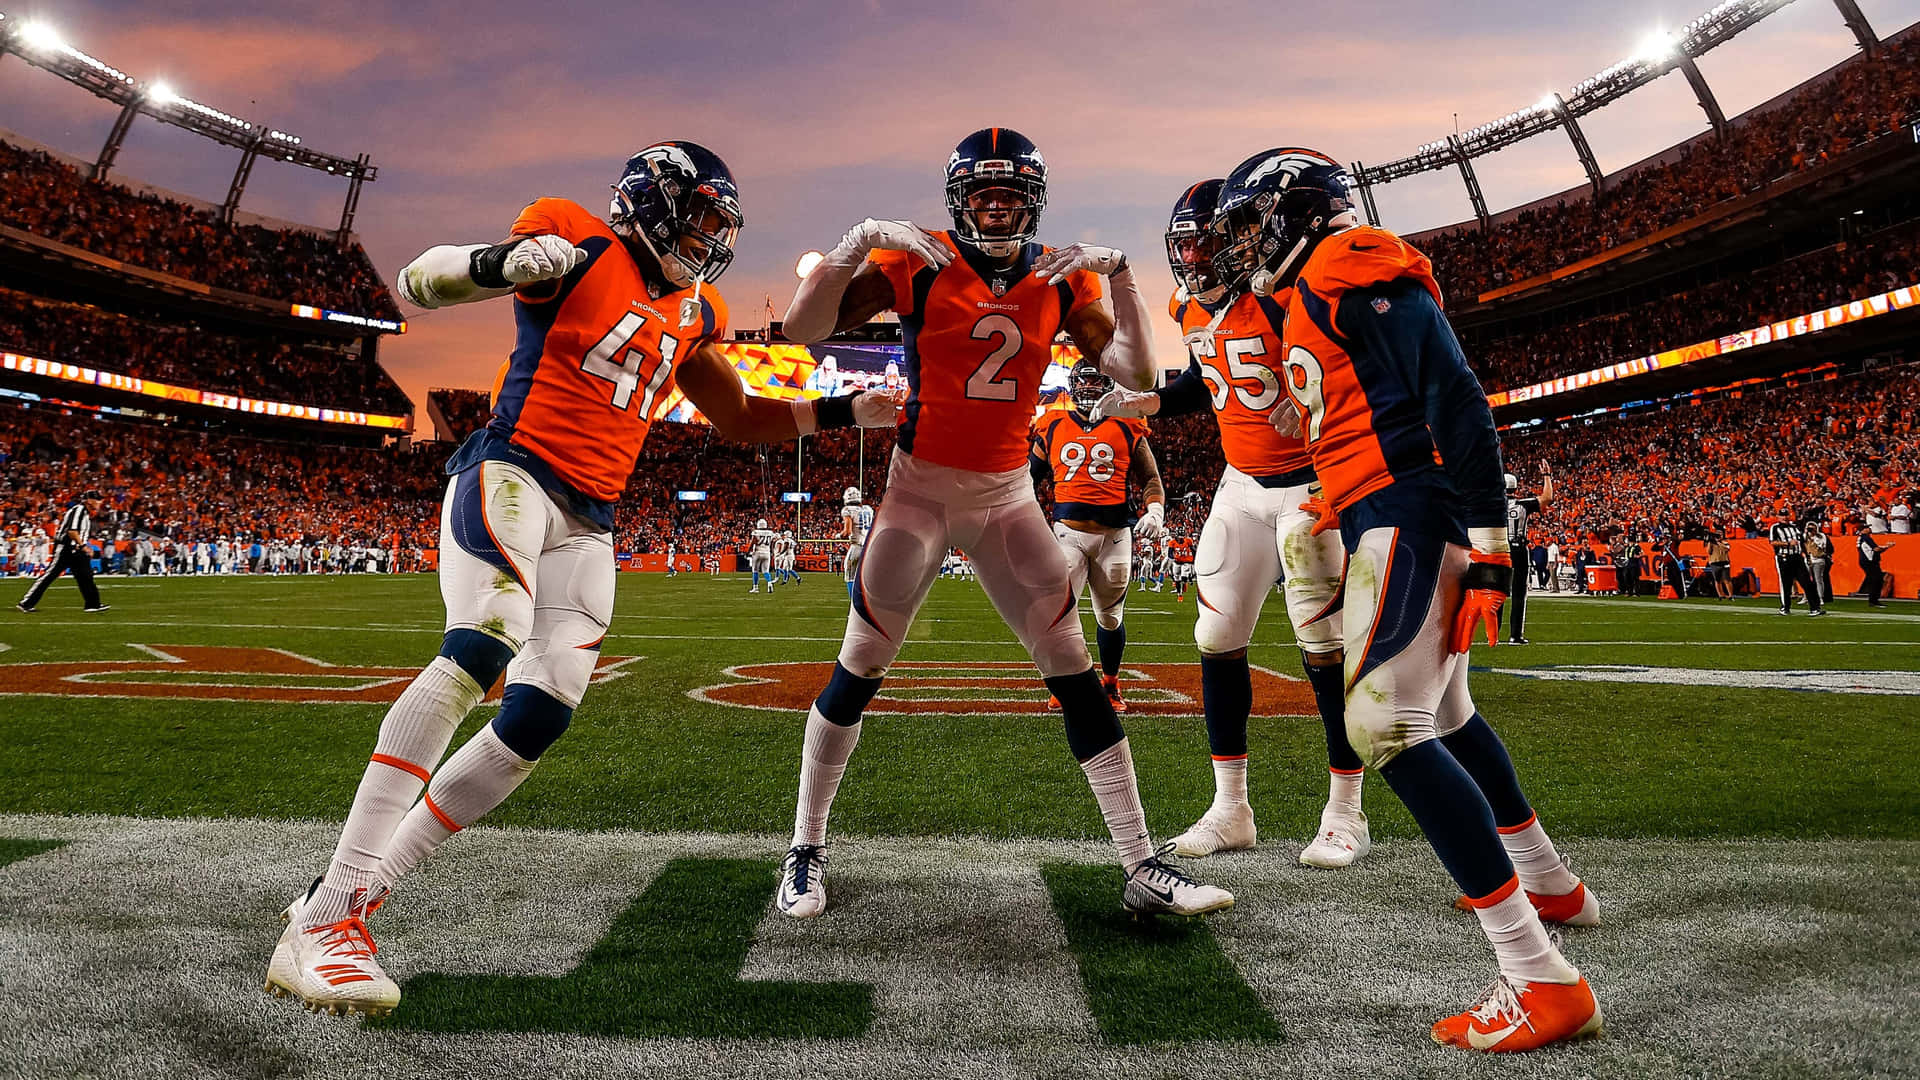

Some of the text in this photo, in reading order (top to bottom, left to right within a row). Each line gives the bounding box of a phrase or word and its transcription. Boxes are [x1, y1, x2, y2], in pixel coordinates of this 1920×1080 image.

[631, 299, 668, 324] BRONCOS
[977, 301, 1020, 311] BRONCOS
[580, 310, 679, 423] 41
[965, 313, 1018, 401] 2
[1191, 336, 1281, 411] 55
[1060, 441, 1115, 482] 98
[1587, 571, 1595, 584] G
